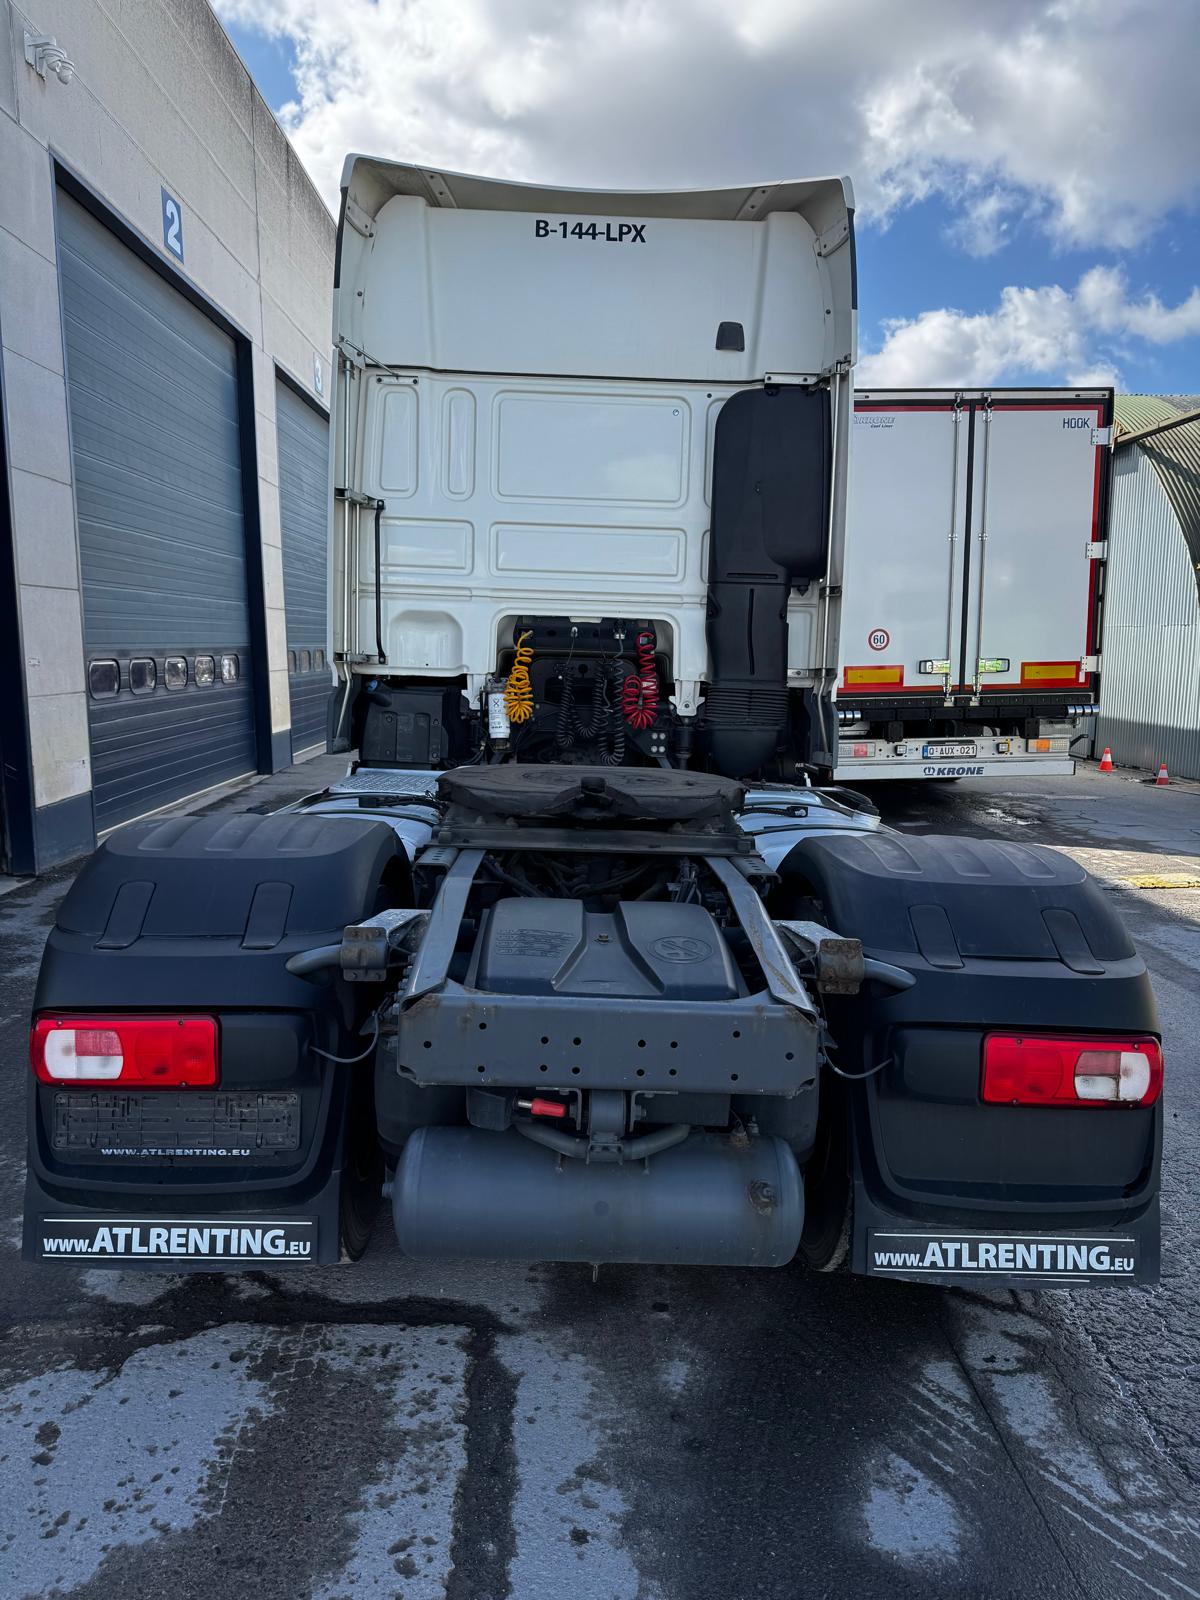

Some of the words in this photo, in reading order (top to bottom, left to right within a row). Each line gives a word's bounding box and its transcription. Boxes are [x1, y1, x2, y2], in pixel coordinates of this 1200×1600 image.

[166, 199, 181, 255] 2
[535, 219, 646, 243] B-144-LPX
[1063, 417, 1090, 429] HOOK
[873, 634, 885, 644] 60
[937, 767, 984, 776] KRONE
